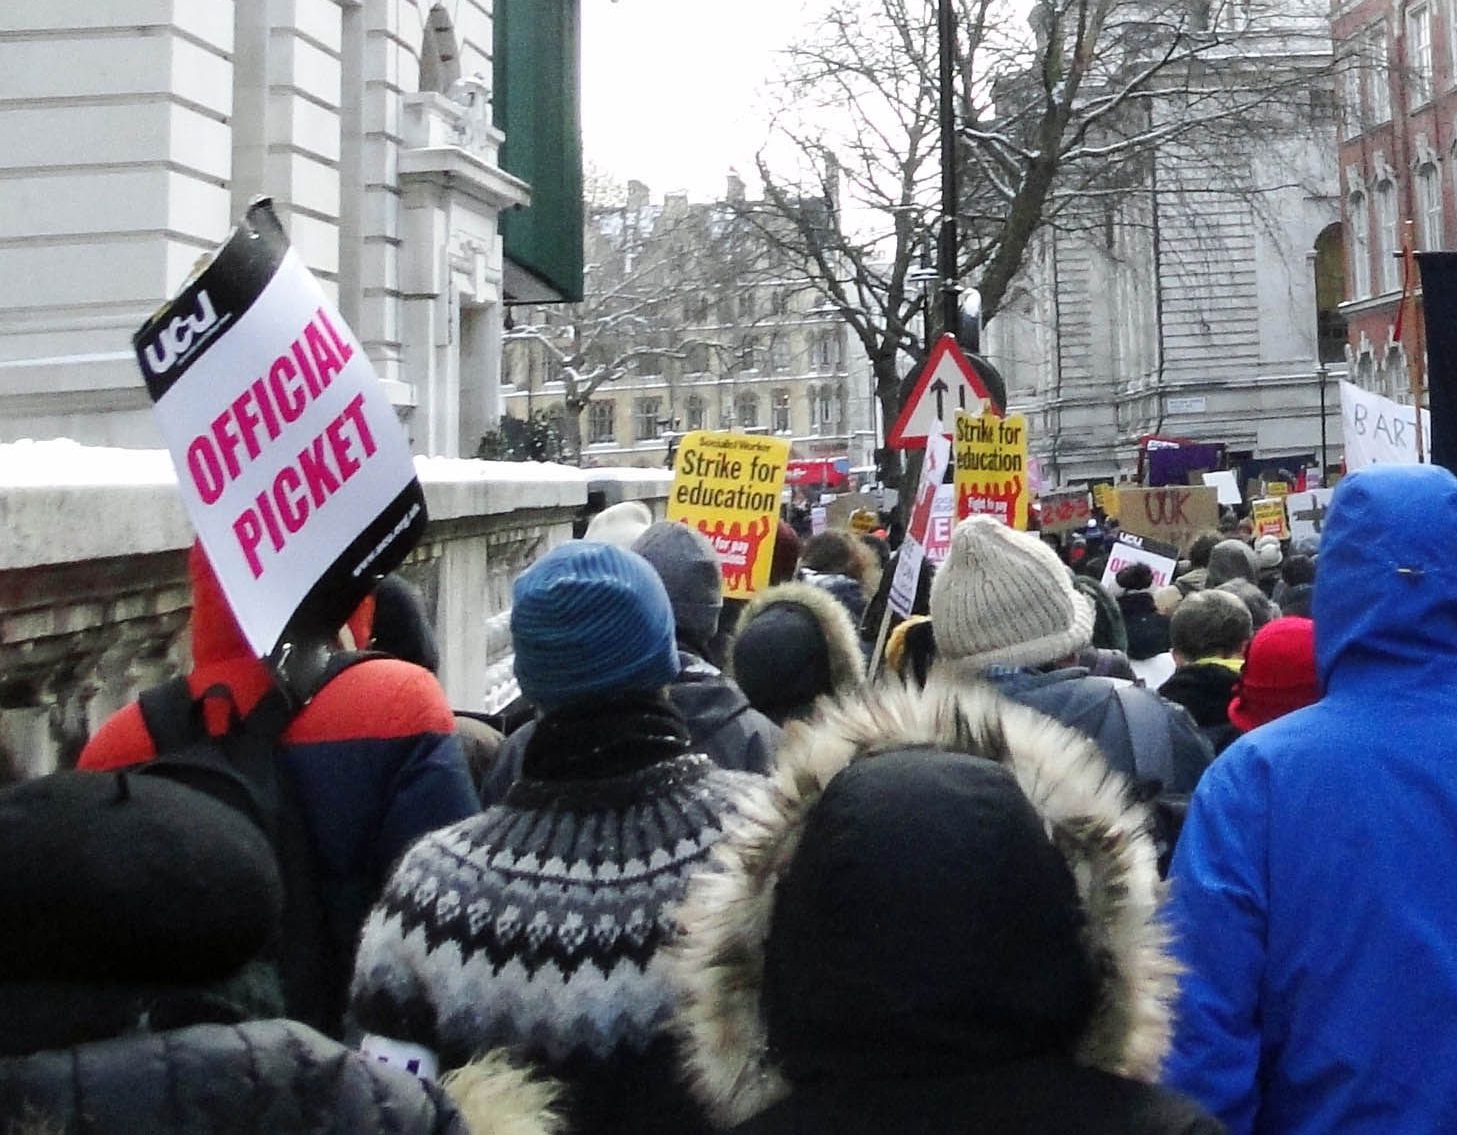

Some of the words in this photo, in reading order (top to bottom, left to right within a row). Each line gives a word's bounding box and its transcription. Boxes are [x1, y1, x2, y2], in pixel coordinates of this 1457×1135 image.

[144, 289, 218, 374] UCU
[187, 307, 353, 505] OFFICIAL
[957, 417, 993, 442] Strike
[1000, 419, 1021, 445] for
[682, 449, 742, 479] Strike
[750, 455, 781, 483] for
[957, 448, 1022, 471] education
[232, 392, 377, 580] PICKET
[677, 480, 776, 511] education
